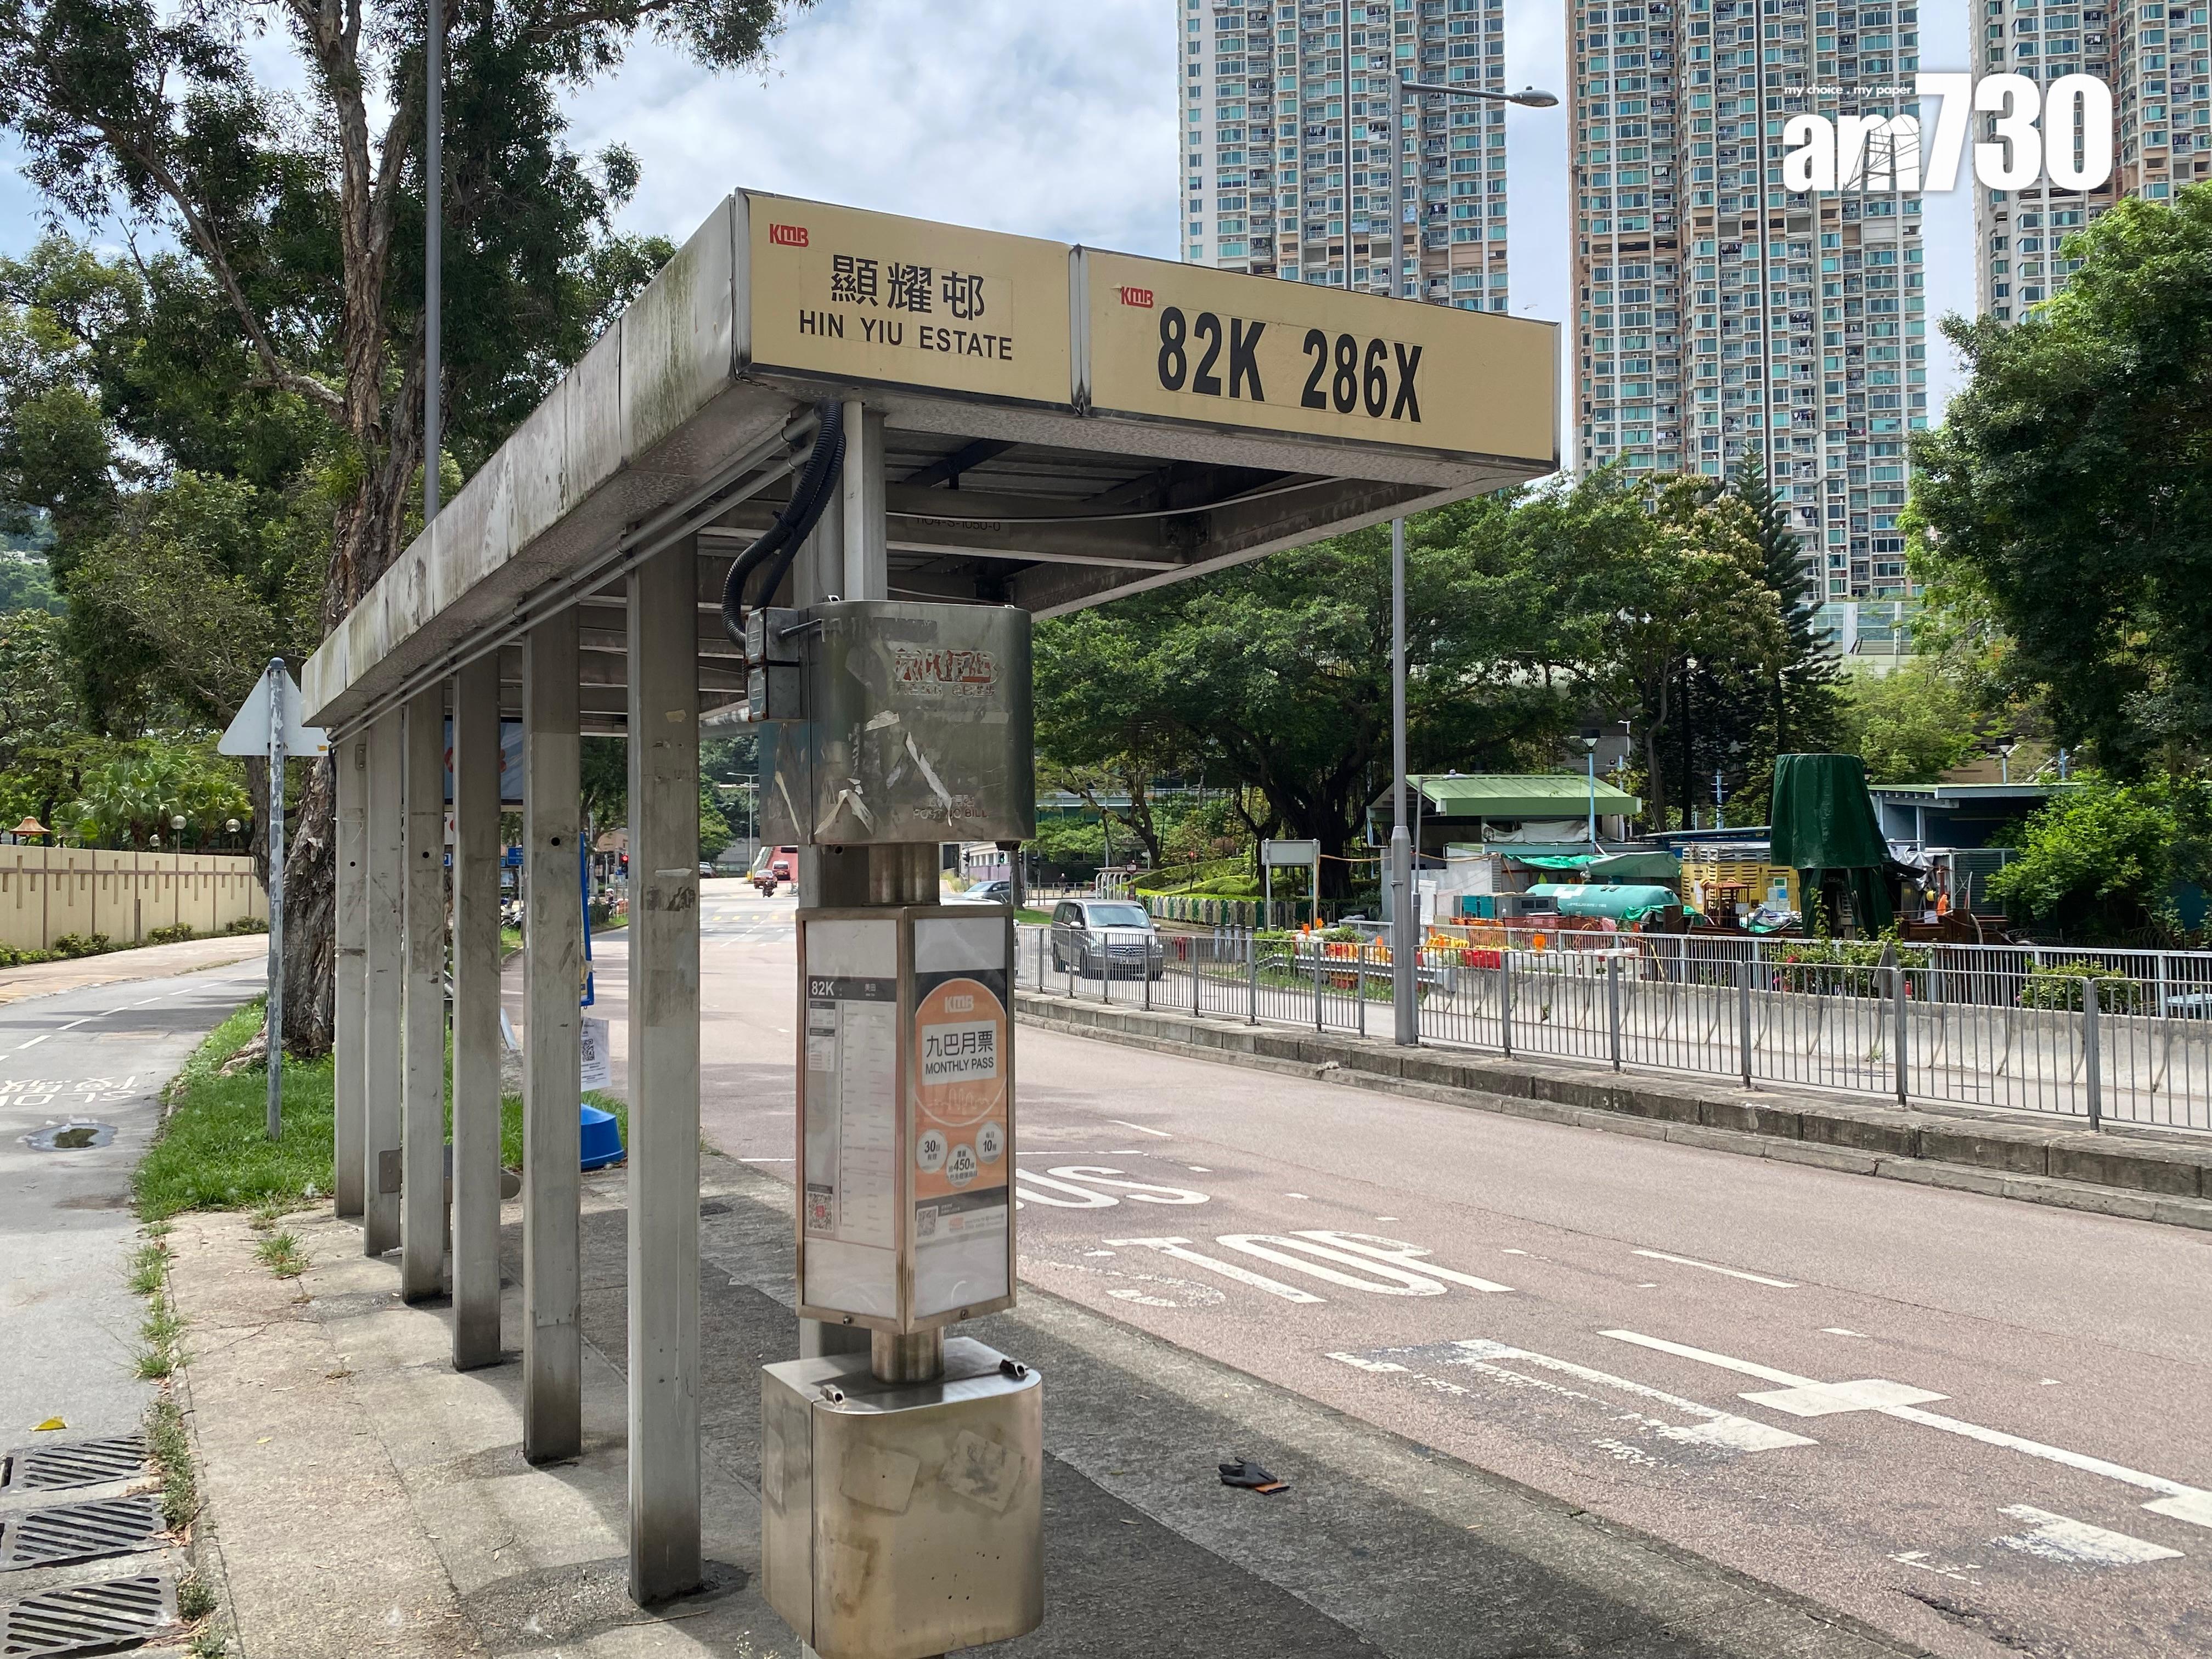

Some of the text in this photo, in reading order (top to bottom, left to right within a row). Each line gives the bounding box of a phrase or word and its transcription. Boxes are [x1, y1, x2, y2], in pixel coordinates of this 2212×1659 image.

[769, 223, 809, 248] KMB
[831, 254, 985, 321] 顯耀邨
[1120, 286, 1154, 309] KMB
[799, 309, 1013, 361] HIN YIU ESTATE
[1158, 306, 1423, 423] 82K 286X
[811, 980, 834, 996] 82K
[926, 1030, 994, 1058] 九巴月票
[926, 1057, 994, 1075] MONTHLY PASS
[1016, 1165, 1211, 1210] US
